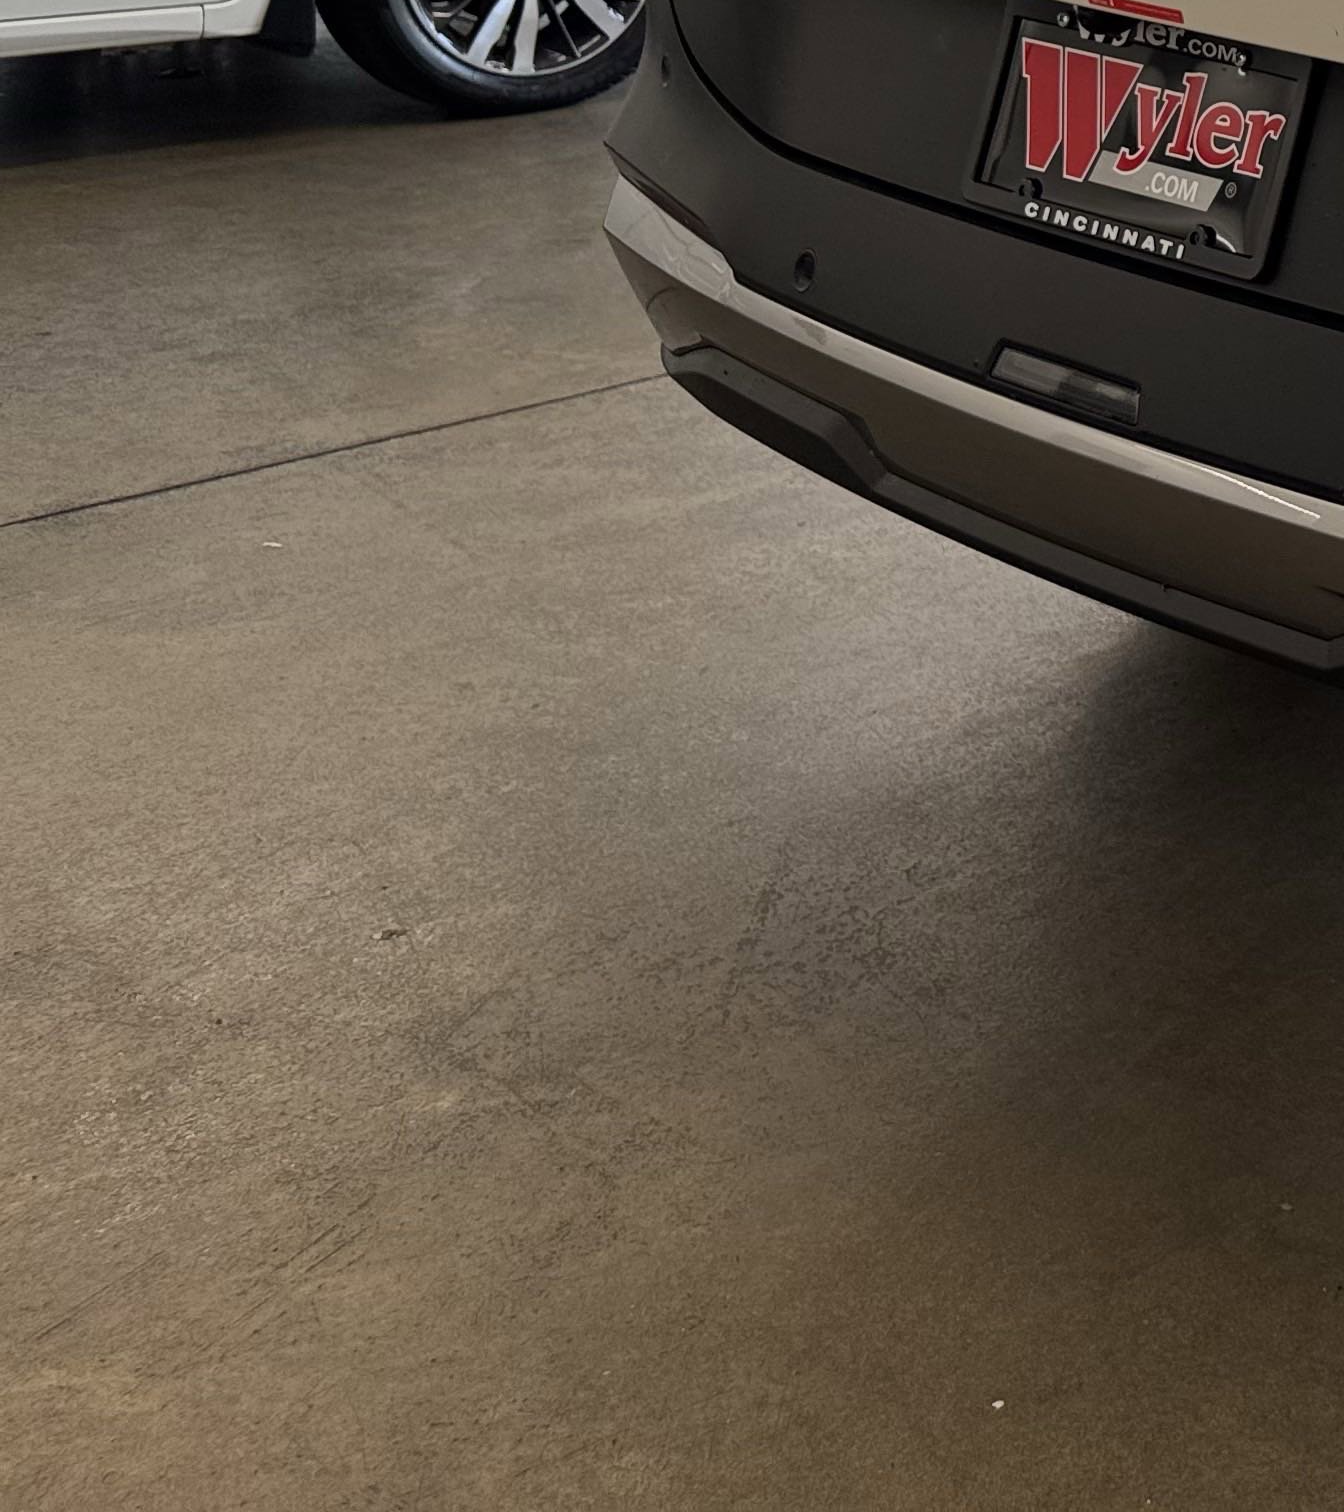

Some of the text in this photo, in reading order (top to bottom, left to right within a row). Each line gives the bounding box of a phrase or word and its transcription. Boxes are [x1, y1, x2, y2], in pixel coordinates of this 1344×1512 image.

[1021, 36, 1286, 183] Wyler
[1144, 171, 1200, 204] .COM
[1023, 201, 1186, 260] CINCINNATI
